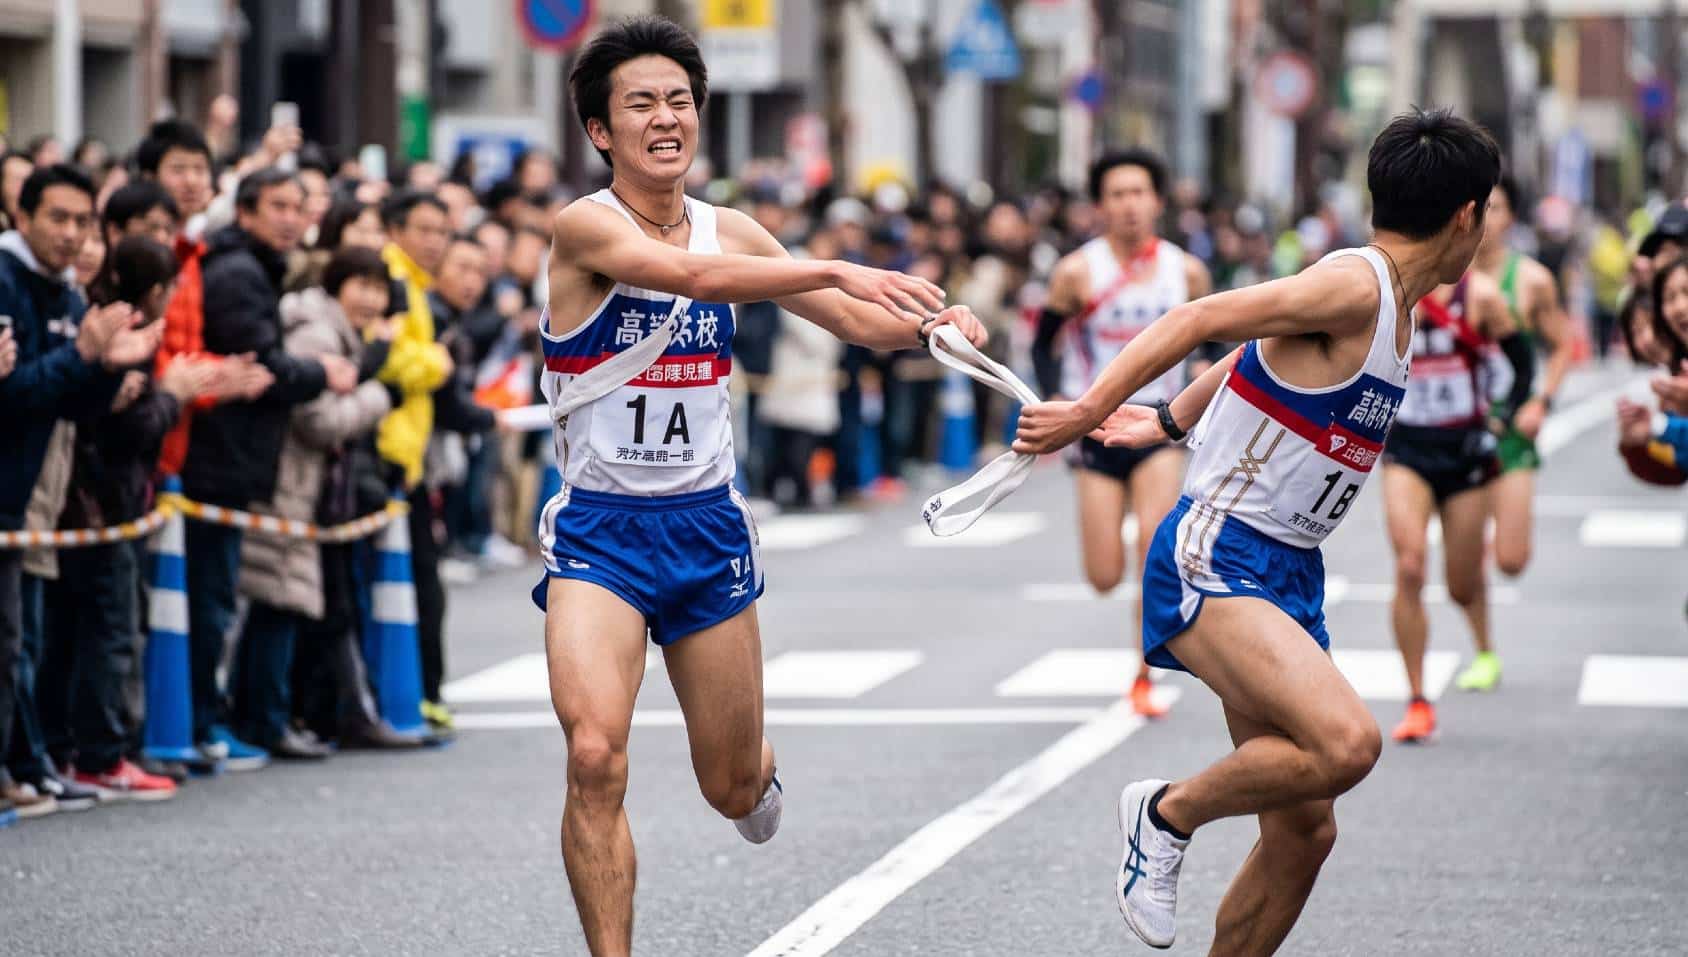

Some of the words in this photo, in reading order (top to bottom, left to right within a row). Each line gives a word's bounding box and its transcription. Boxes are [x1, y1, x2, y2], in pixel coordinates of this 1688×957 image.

[627, 394, 646, 444] 1
[662, 402, 690, 444] A
[1310, 470, 1344, 514] 1
[1327, 483, 1359, 519] B
